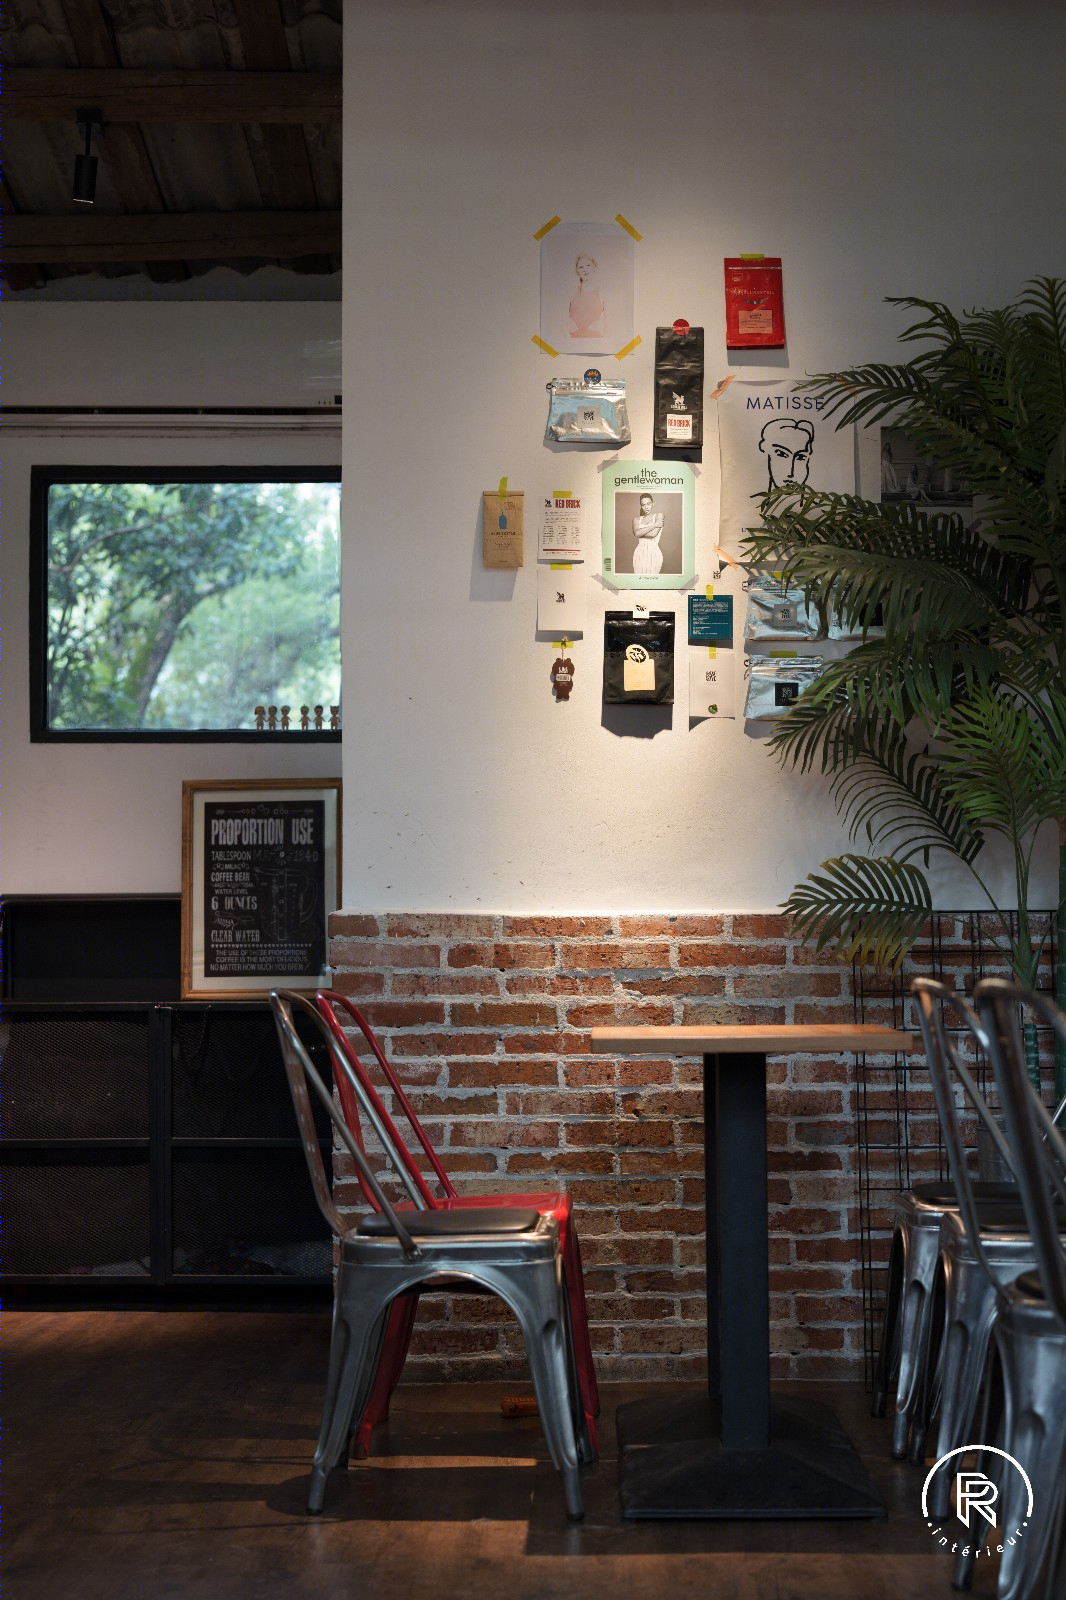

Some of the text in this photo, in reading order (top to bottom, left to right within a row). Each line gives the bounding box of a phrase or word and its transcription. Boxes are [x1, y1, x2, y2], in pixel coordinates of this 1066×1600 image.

[746, 396, 825, 410] MATISSE
[640, 468, 657, 478] the
[614, 475, 684, 487] gentlewoman
[211, 818, 314, 846] PROPORTION USE
[211, 850, 252, 861] TABLESPOON
[211, 871, 250, 882] COFFEE BEAN
[211, 896, 258, 911] 6 OUNCES
[211, 930, 260, 942] CLEAR WATER
[210, 963, 219, 971] NO
[219, 963, 242, 971] MATTER
[242, 963, 256, 971] HOW
[257, 963, 274, 971] MUCH
[274, 963, 287, 971] YOU
